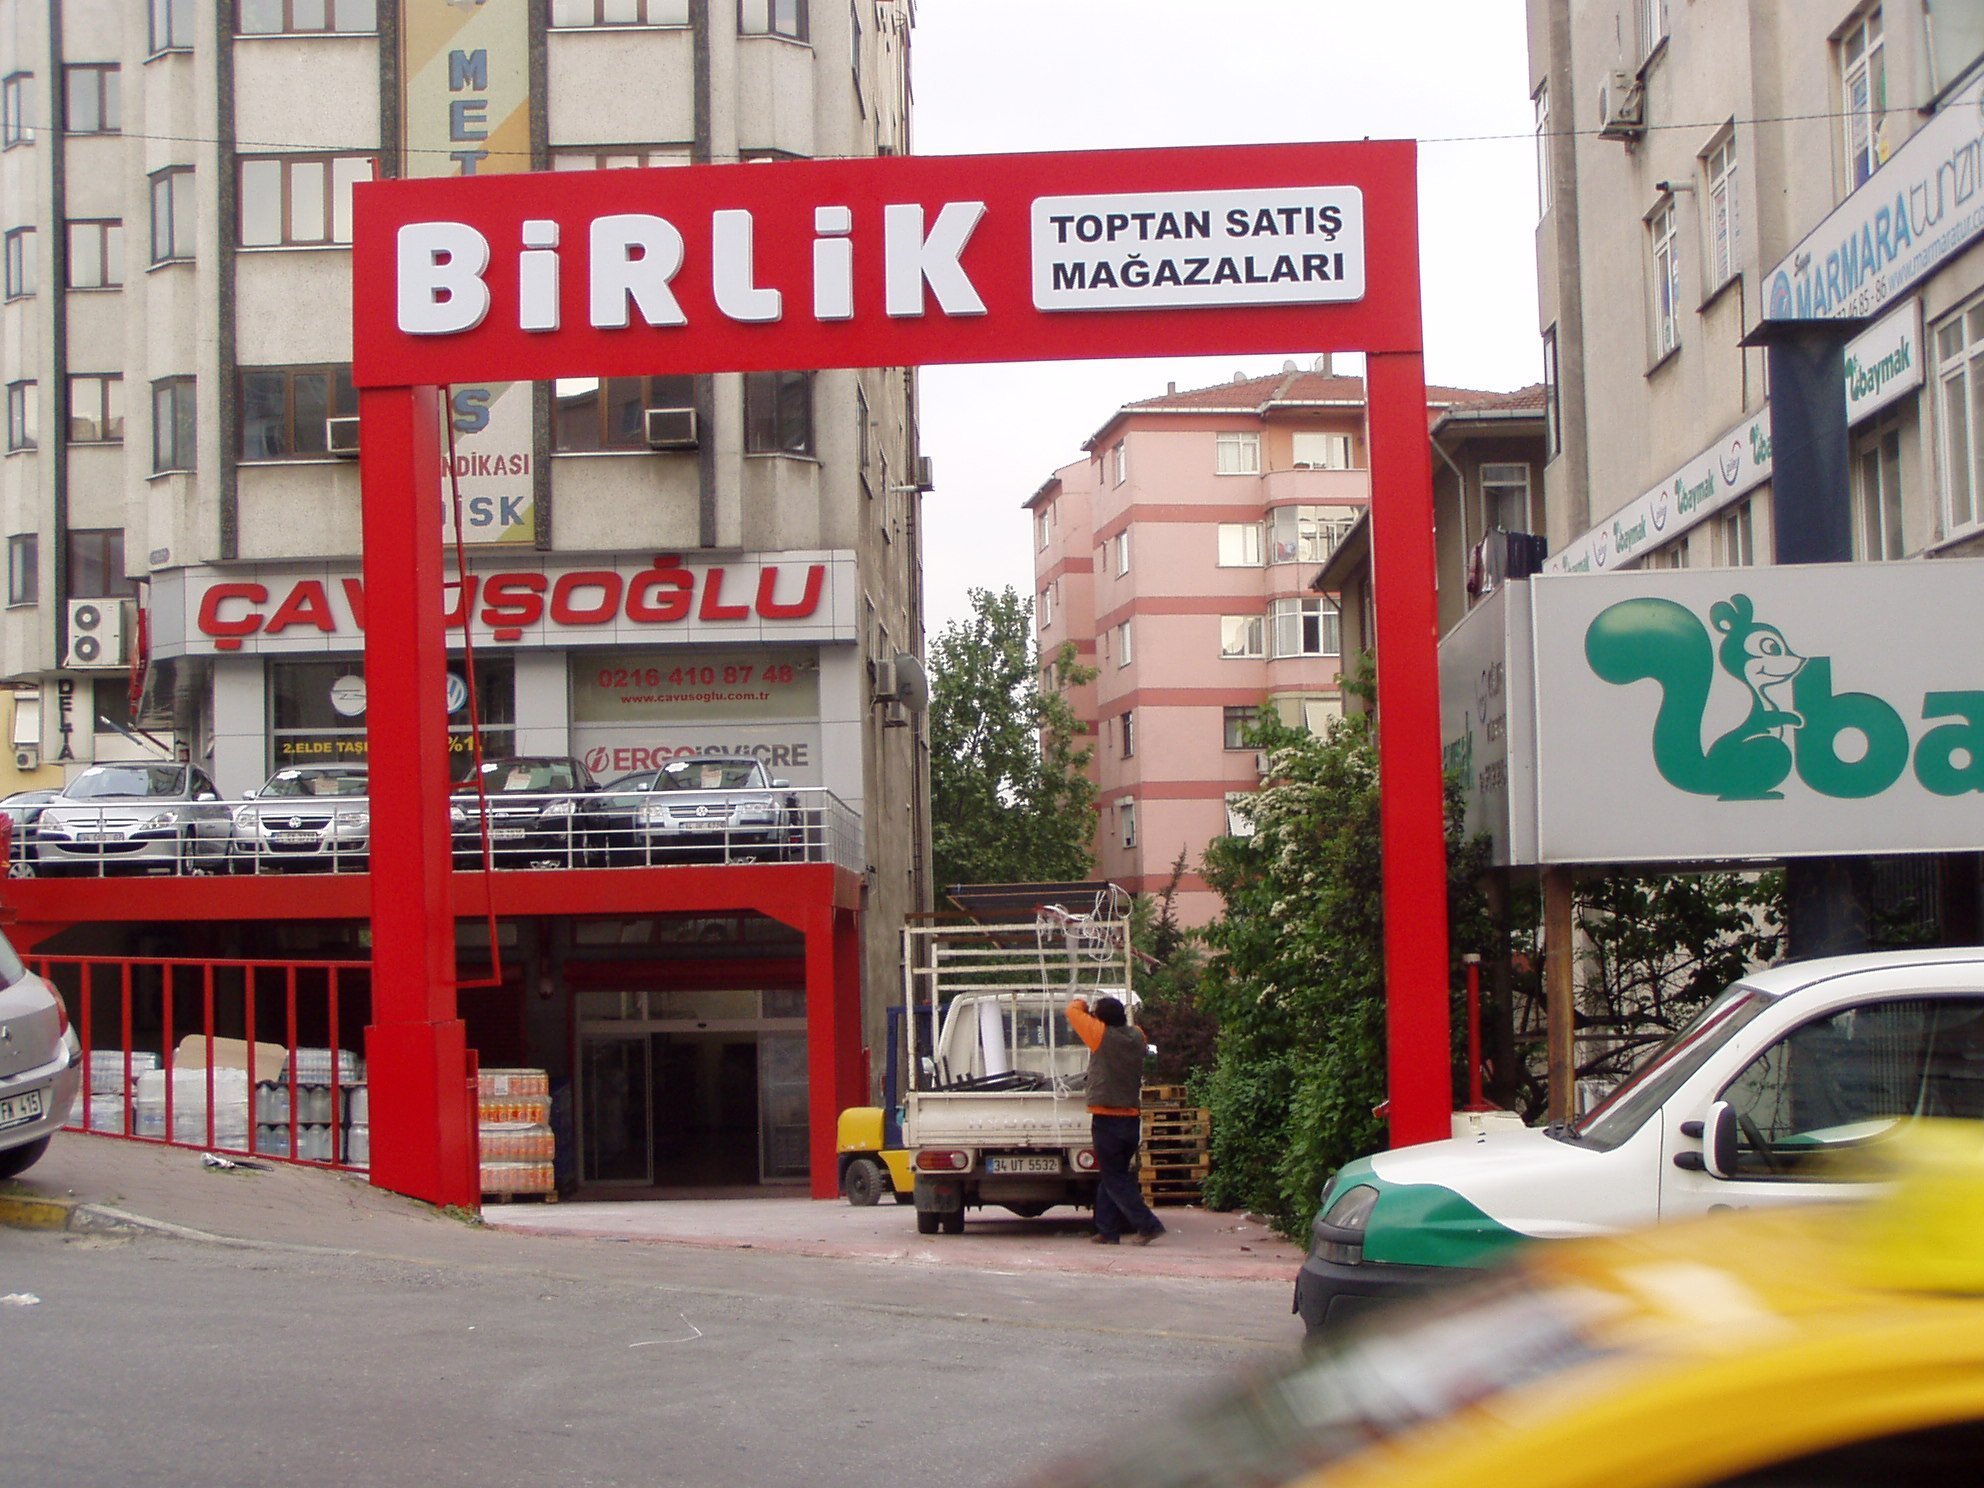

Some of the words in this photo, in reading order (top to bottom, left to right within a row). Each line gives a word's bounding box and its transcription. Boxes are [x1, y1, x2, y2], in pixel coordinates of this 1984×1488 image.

[1050, 210, 1211, 244] TOPTAN
[1225, 205, 1343, 242] SATIŞ
[1052, 252, 1345, 291] MAĞAZALARI
[1858, 335, 1910, 397] baymak
[598, 667, 660, 689] 0216
[668, 666, 715, 686] 410
[723, 665, 753, 684] 87
[762, 664, 794, 684] 48
[620, 690, 771, 704] www.cavusoglu.com.tr
[283, 741, 332, 754] 2.ELDE
[994, 1160, 1007, 1172] 34
[1011, 1159, 1024, 1171] UT
[1029, 1159, 1055, 1171] 5532
